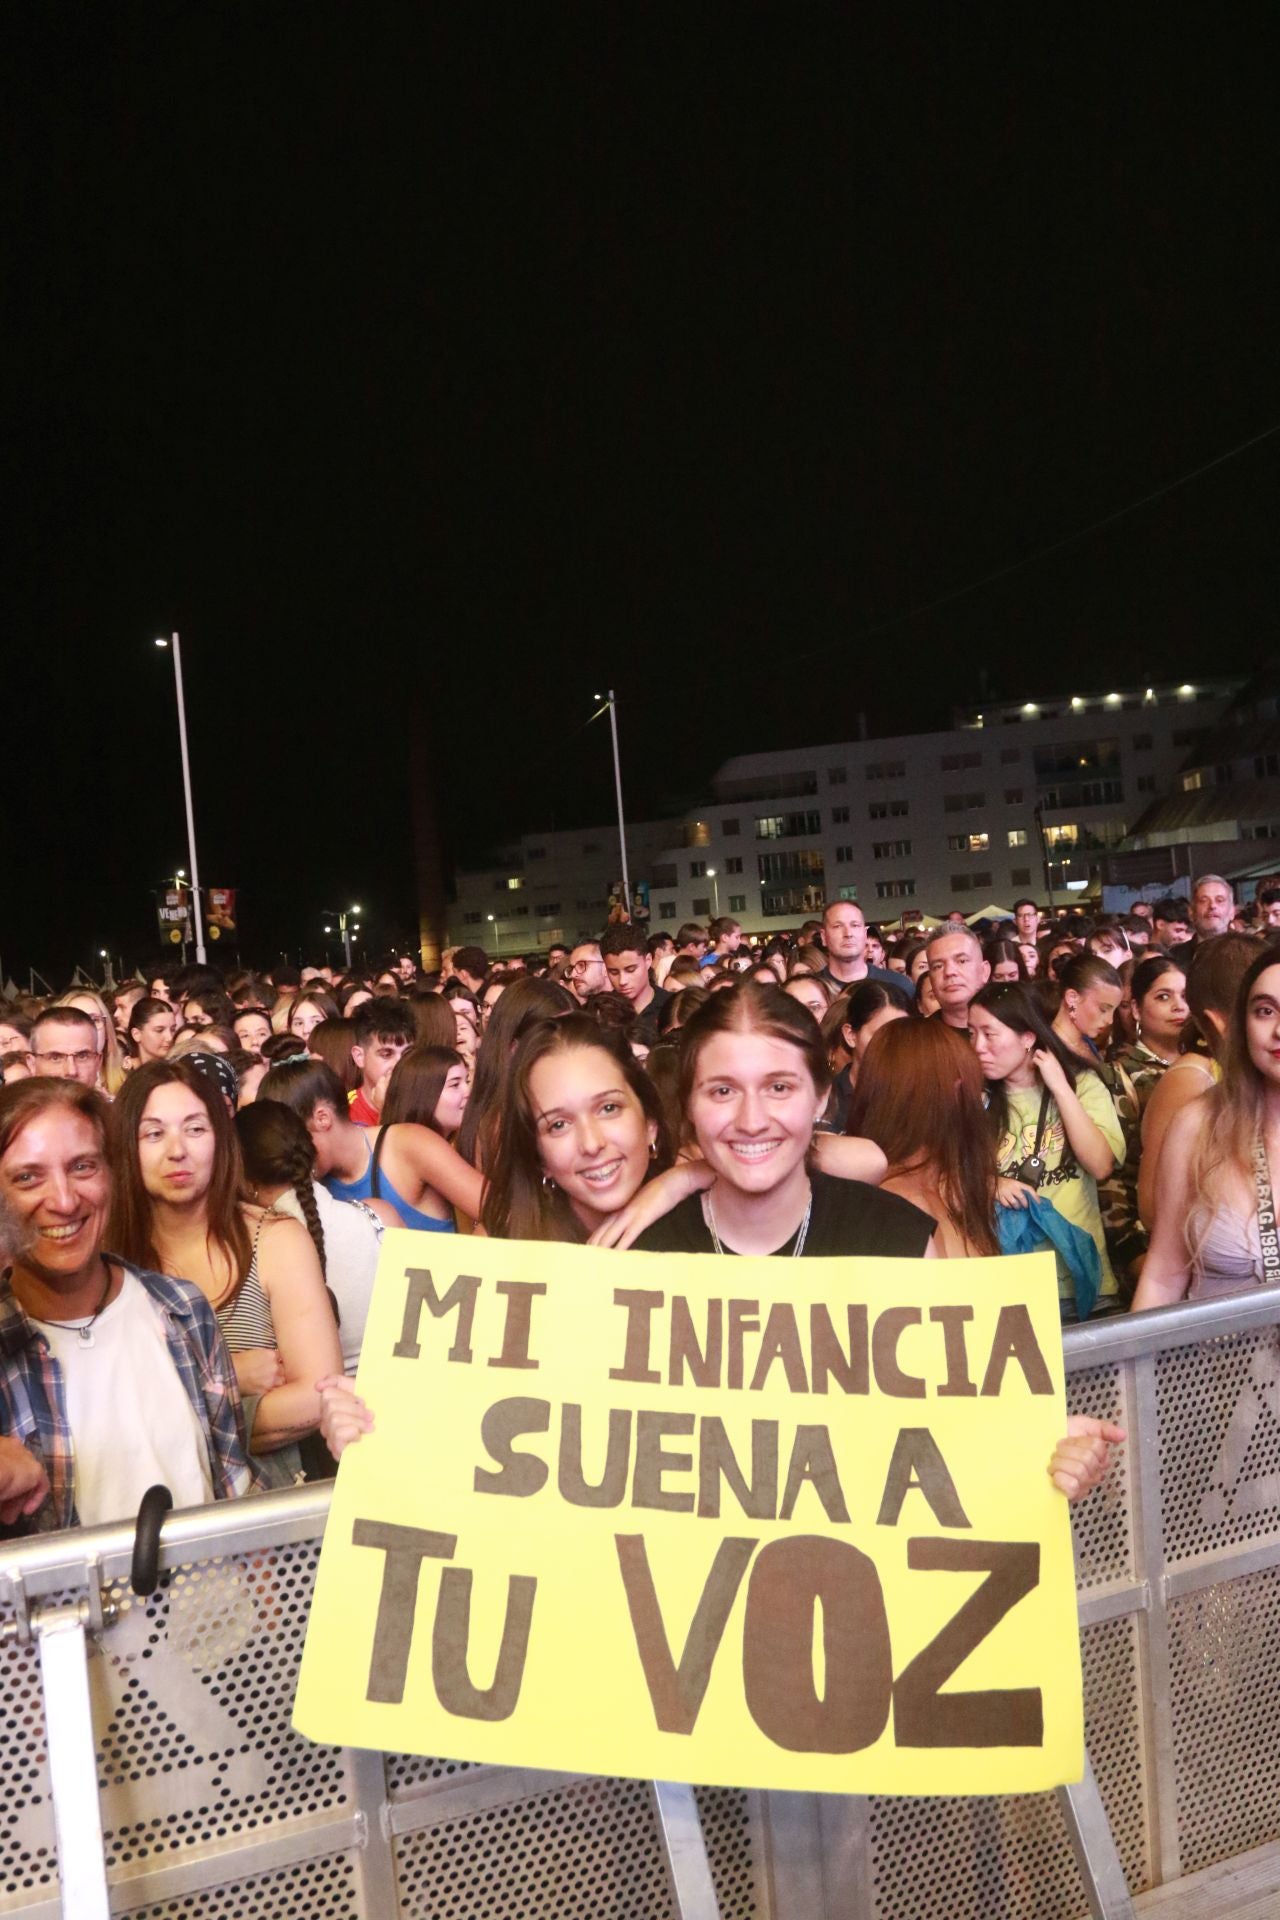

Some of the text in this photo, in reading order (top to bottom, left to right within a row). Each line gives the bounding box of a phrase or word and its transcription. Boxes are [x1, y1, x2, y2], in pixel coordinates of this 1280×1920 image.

[393, 1268, 1054, 1398] MI INFANCIA
[474, 1397, 972, 1528] SUENA A
[352, 1519, 1044, 1754] TU VOZ
